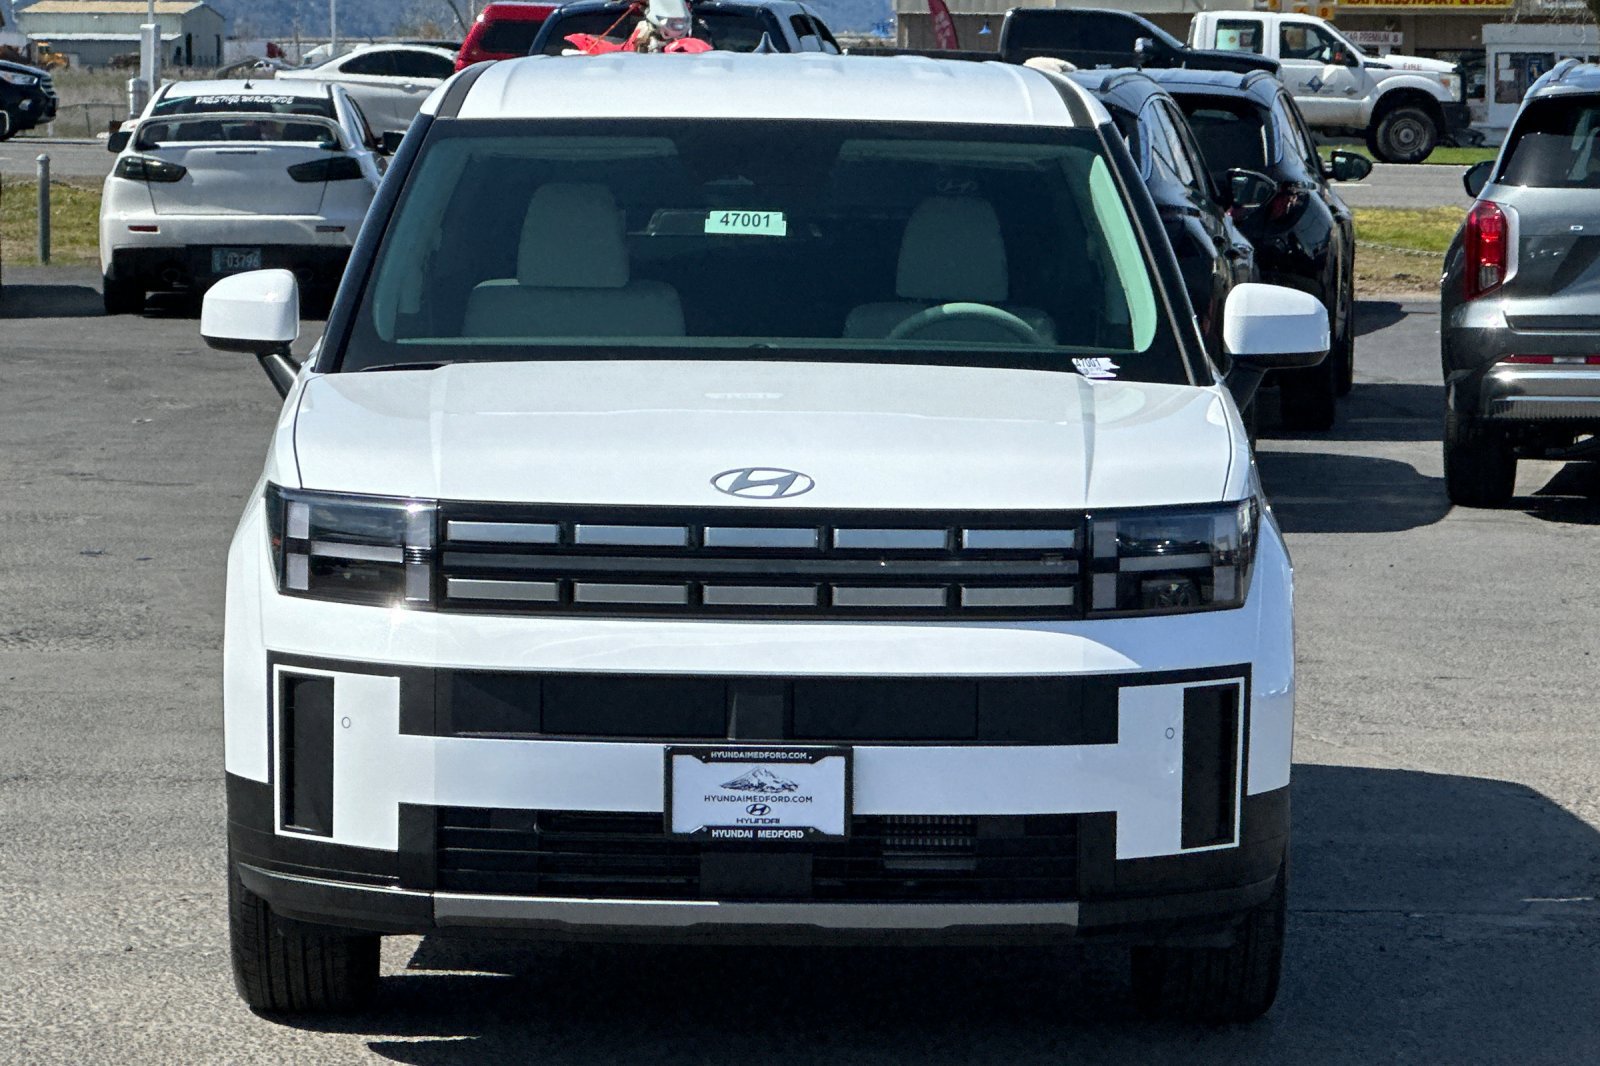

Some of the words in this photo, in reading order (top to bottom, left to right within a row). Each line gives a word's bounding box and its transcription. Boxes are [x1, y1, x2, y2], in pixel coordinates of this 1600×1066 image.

[1403, 63, 1422, 71] FIRE
[720, 212, 771, 227] 47001
[710, 751, 807, 760] HYUNDAIMEDFORD.COM
[703, 795, 813, 804] HYUNDAIMEDFORD.COM
[736, 817, 781, 825] HYUNDAI
[711, 829, 754, 838] HYUNDAI
[757, 829, 804, 838] MEDFORD
